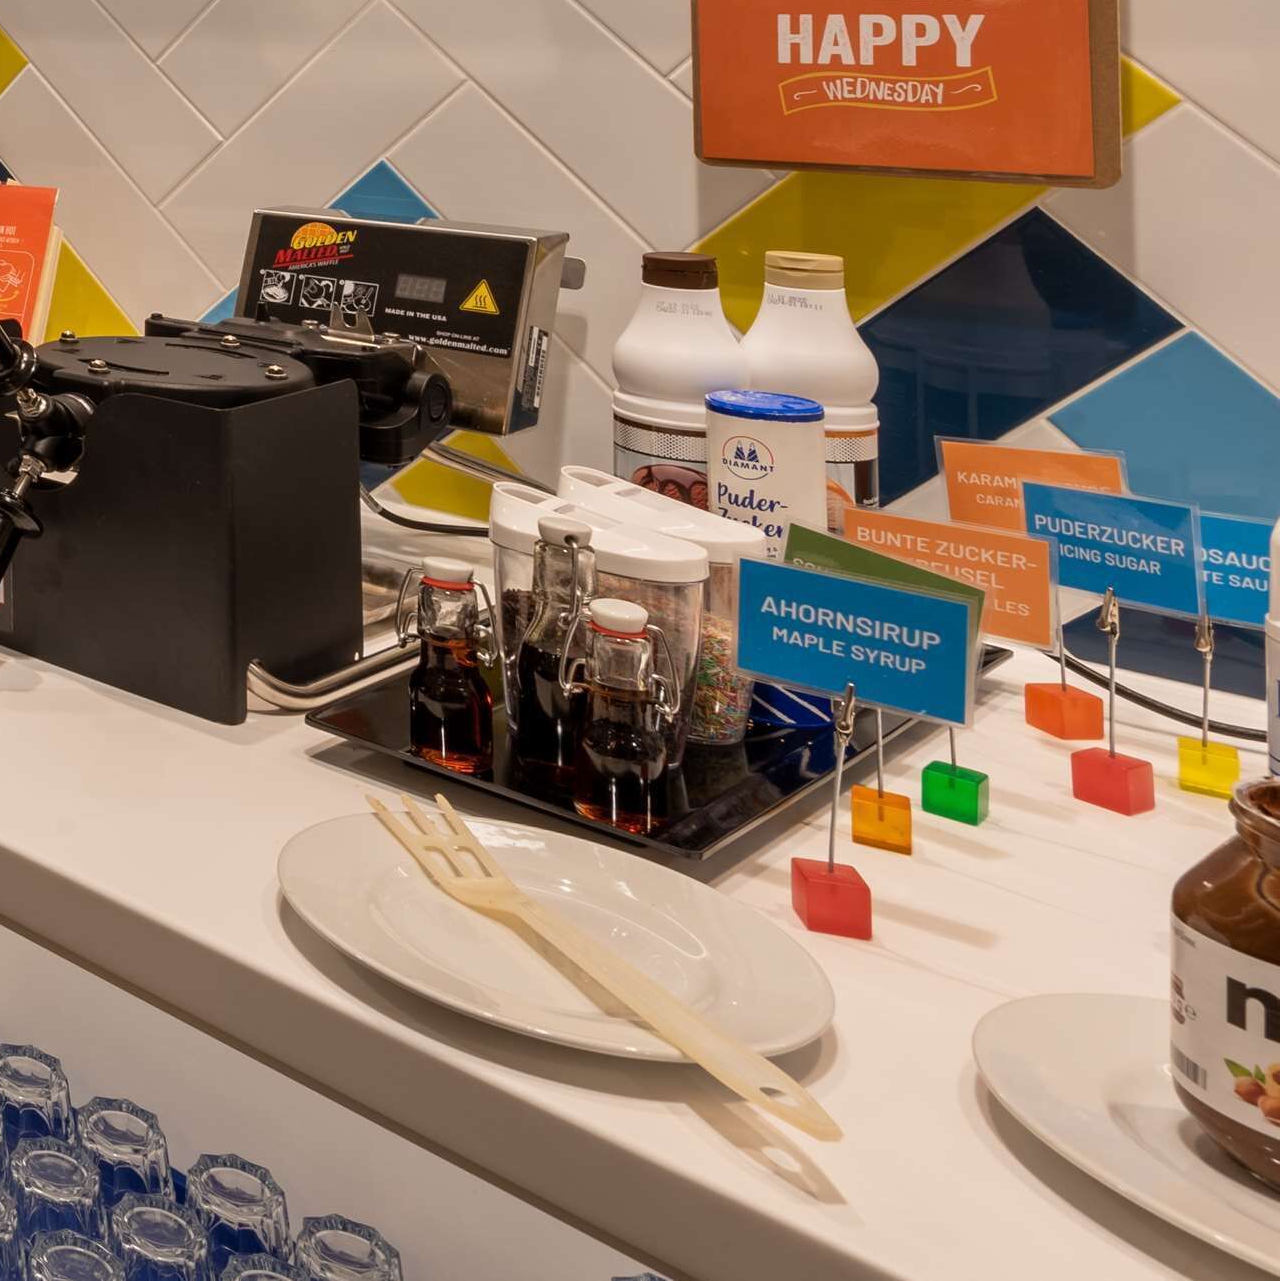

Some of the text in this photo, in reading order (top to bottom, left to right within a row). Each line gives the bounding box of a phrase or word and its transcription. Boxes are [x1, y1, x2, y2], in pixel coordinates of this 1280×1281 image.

[777, 14, 986, 68] HAPPY
[822, 78, 945, 105] WEDNESDAY
[274, 245, 338, 263] MALTED
[292, 230, 357, 250] GOLDEN
[385, 308, 404, 316] MADE
[432, 314, 447, 322] USA
[408, 334, 508, 356] www.goldenmalted.com
[722, 457, 774, 473] DIAMANT
[717, 482, 789, 513] Puder-
[857, 526, 1039, 570] BUNTE ZUCKER-
[1034, 514, 1185, 557] PUDERZUCKER
[1059, 543, 1162, 576] ICING SUGAR
[760, 596, 941, 651] AHORNSIRUP
[772, 626, 926, 674] MAPLE SYRUP
